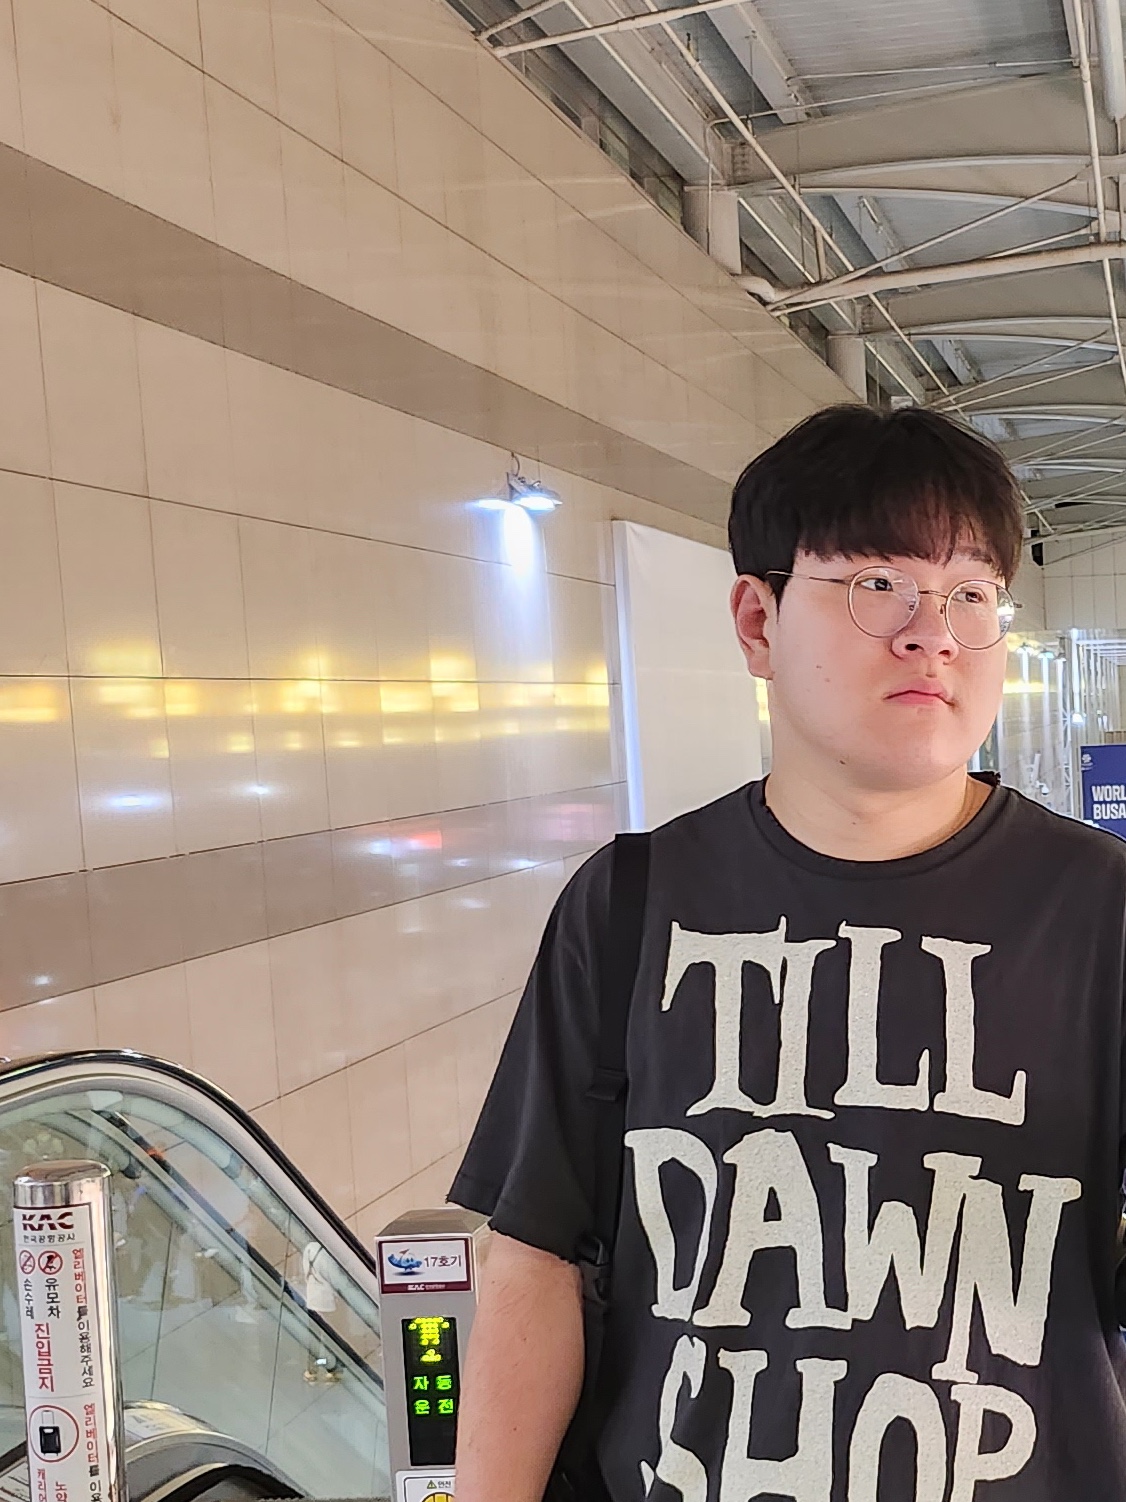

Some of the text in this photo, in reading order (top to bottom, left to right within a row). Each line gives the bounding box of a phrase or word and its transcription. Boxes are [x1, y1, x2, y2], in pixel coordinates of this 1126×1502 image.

[661, 915, 1027, 1126] TILL
[22, 1211, 75, 1231] KAC
[23, 1233, 76, 1244] 한국공항공사
[424, 1254, 462, 1268] 17호기
[624, 1128, 1082, 1383] DAWN
[23, 1278, 35, 1320] 손수레
[44, 1278, 62, 1320] 유모차
[35, 1322, 55, 1393] 진입금지
[413, 1375, 452, 1391] 자동
[414, 1399, 454, 1415] 운전
